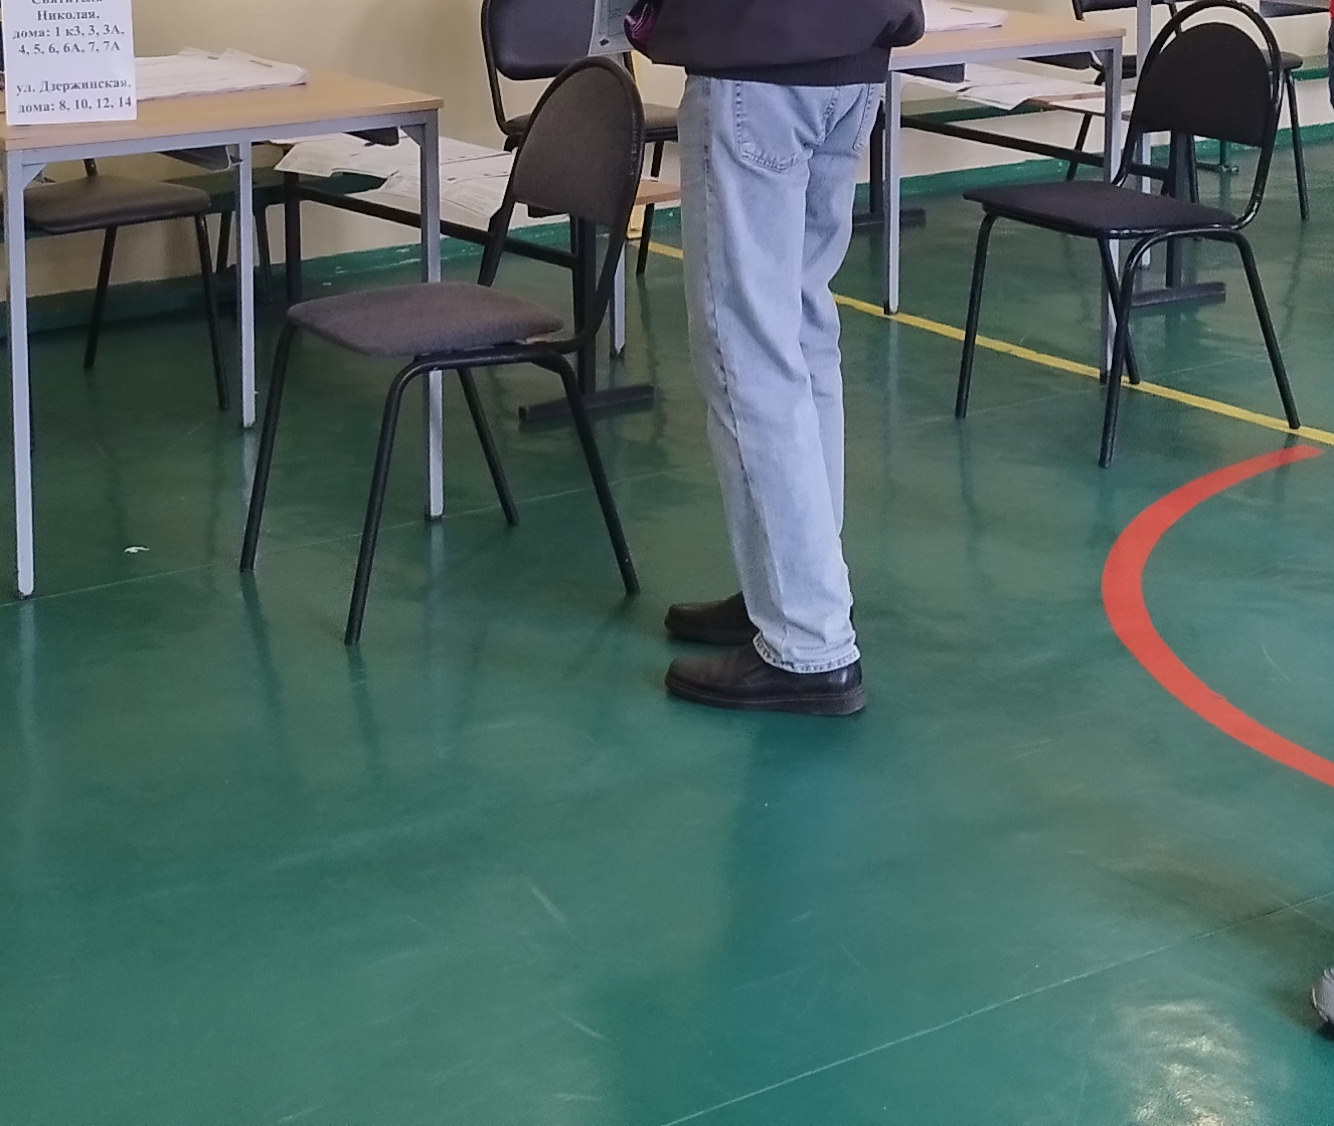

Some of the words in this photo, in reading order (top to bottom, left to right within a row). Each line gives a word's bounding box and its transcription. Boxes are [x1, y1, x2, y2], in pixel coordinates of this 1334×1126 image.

[12, 29, 51, 40] дома:
[55, 26, 61, 37] 1
[19, 43, 30, 56] 4,
[33, 43, 45, 55] 5,
[103, 40, 121, 51] 7А
[16, 84, 36, 97] ул.
[18, 103, 55, 114] дома:
[118, 96, 132, 108] 14
